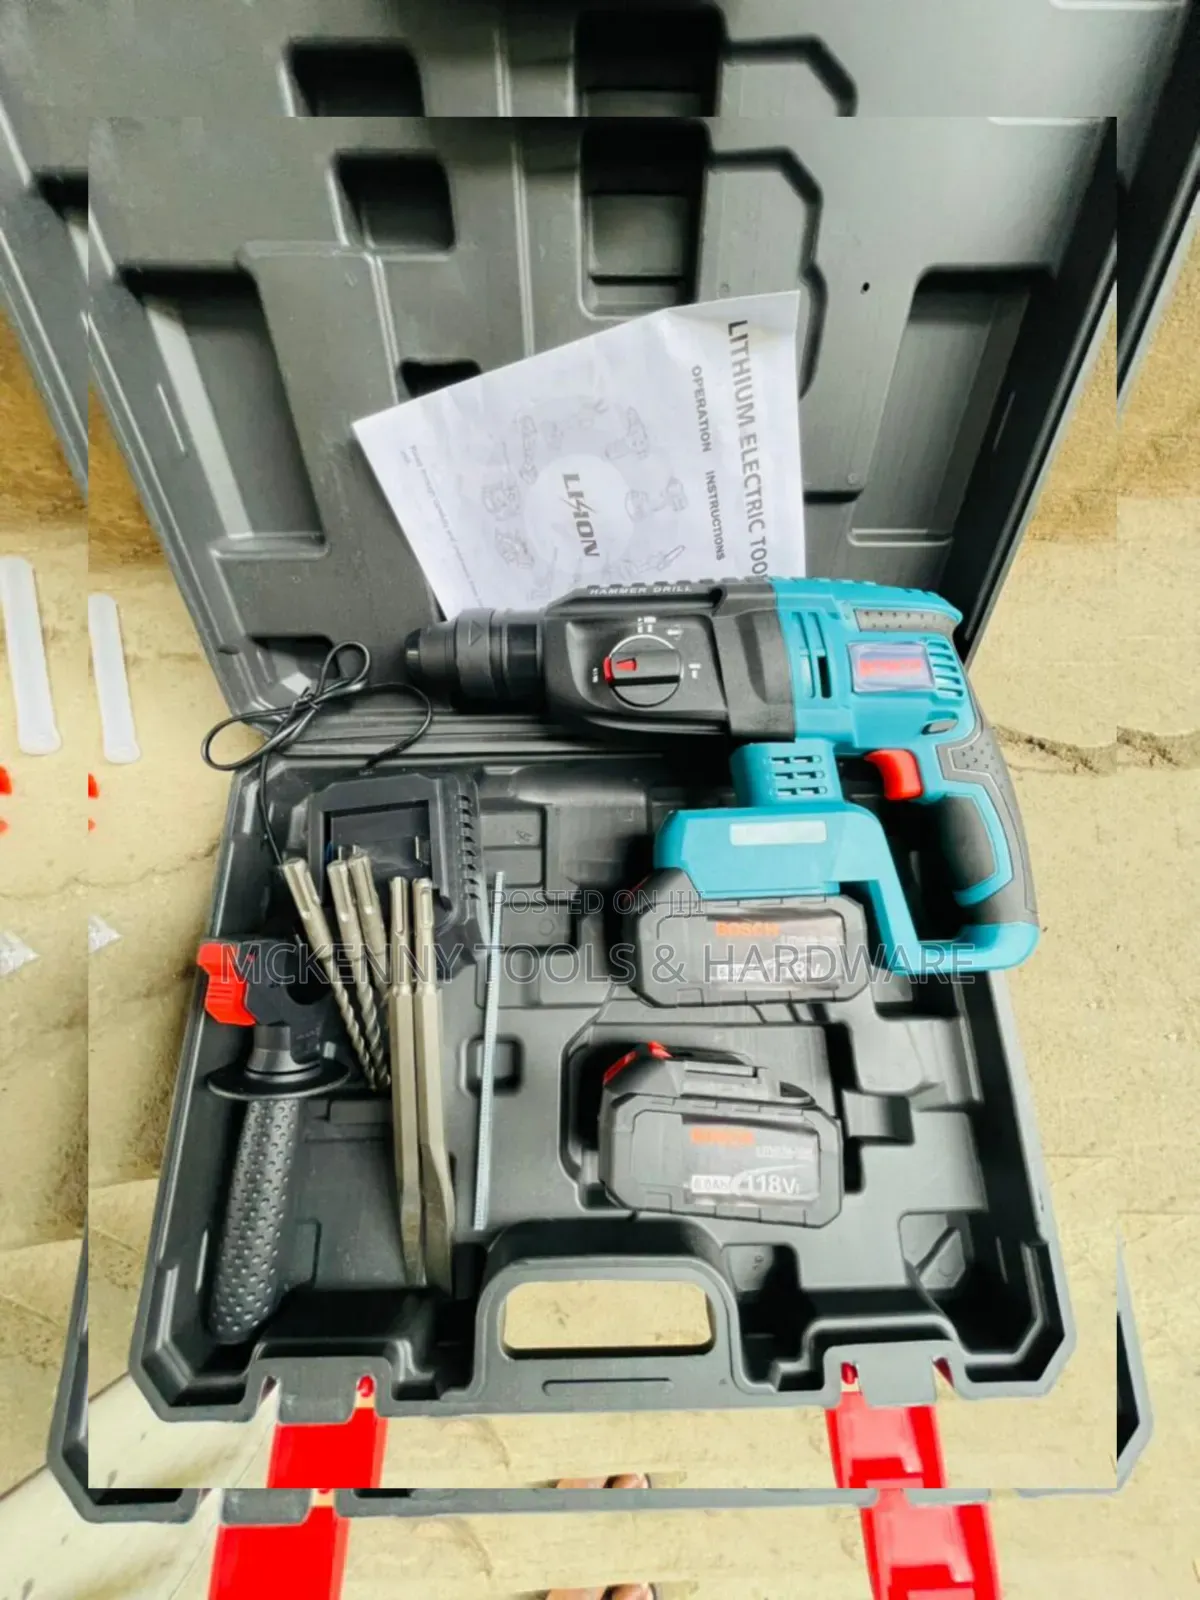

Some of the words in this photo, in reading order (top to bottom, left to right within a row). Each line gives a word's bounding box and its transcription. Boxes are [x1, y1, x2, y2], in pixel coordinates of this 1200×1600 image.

[728, 319, 755, 428] LITHIUM
[691, 365, 712, 453] OPERATION
[705, 469, 726, 561] INSTRUCTIONS
[739, 432, 766, 534] ELECTRIC
[590, 586, 647, 596] HAMMER
[653, 584, 693, 594] DRILL
